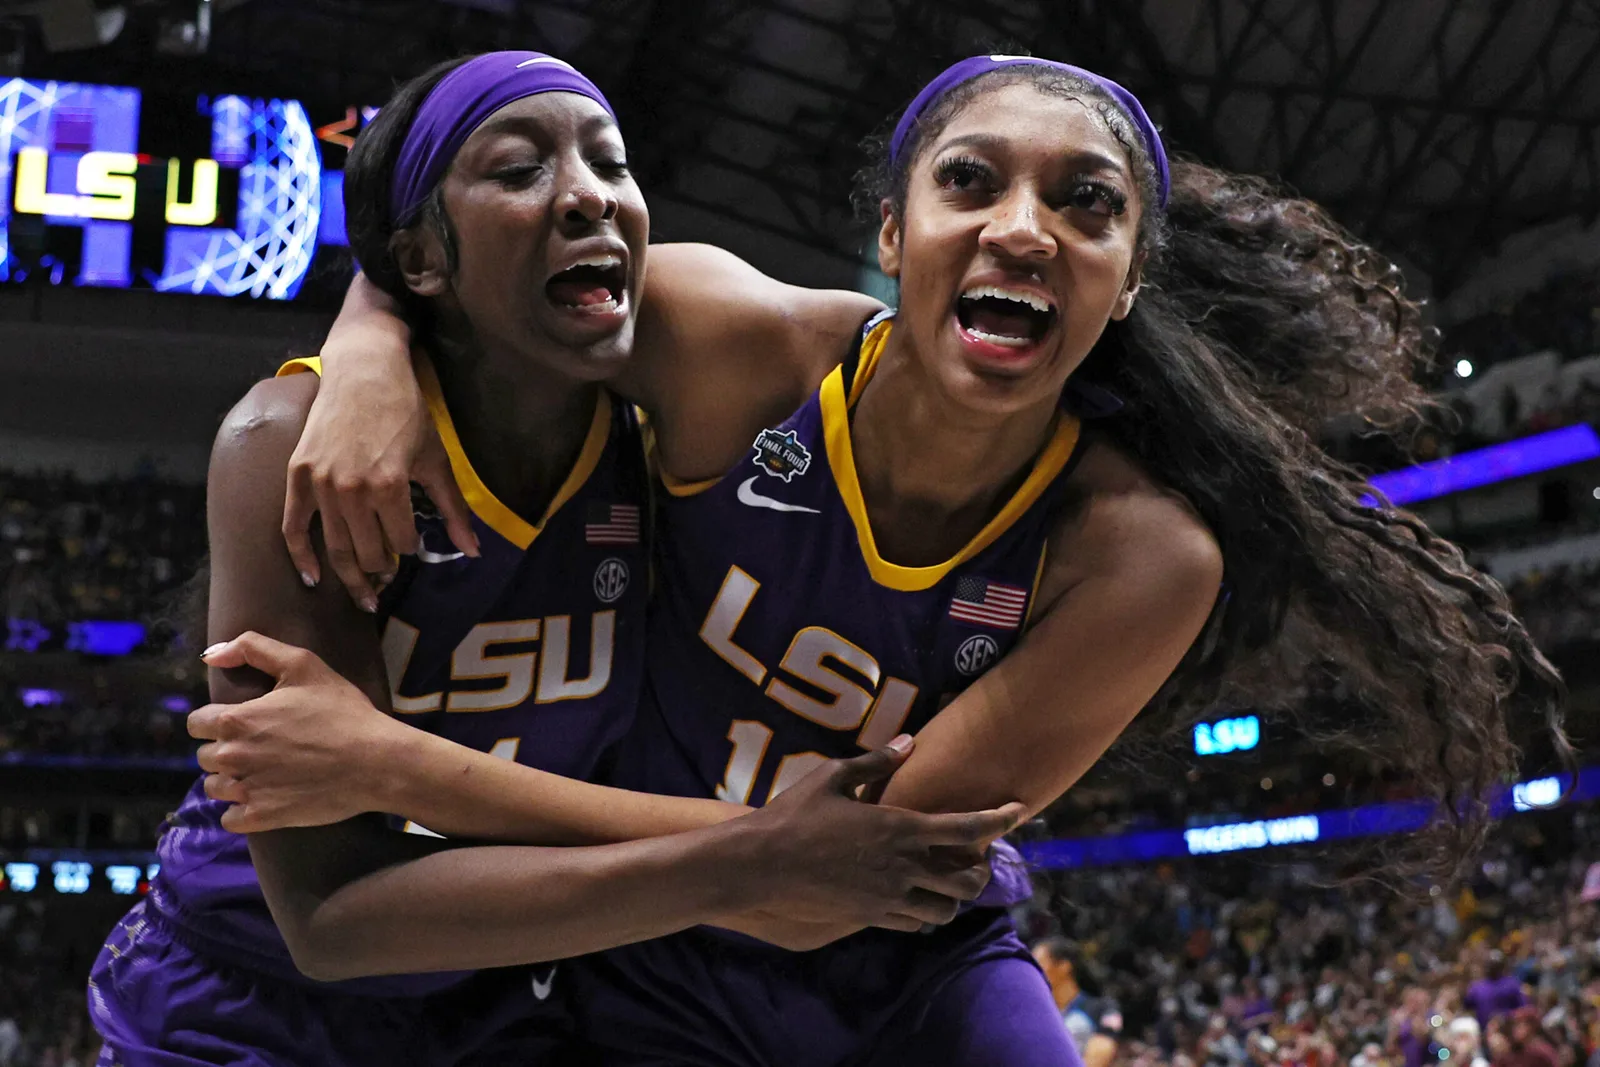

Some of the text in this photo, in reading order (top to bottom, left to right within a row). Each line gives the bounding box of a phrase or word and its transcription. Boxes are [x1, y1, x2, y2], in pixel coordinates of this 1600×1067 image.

[14, 147, 219, 225] LSU
[757, 437, 783, 455] FINAL
[782, 449, 806, 471] FOUR
[381, 610, 616, 714] LSU
[960, 638, 995, 672] SEC
[1194, 715, 1260, 755] LSU
